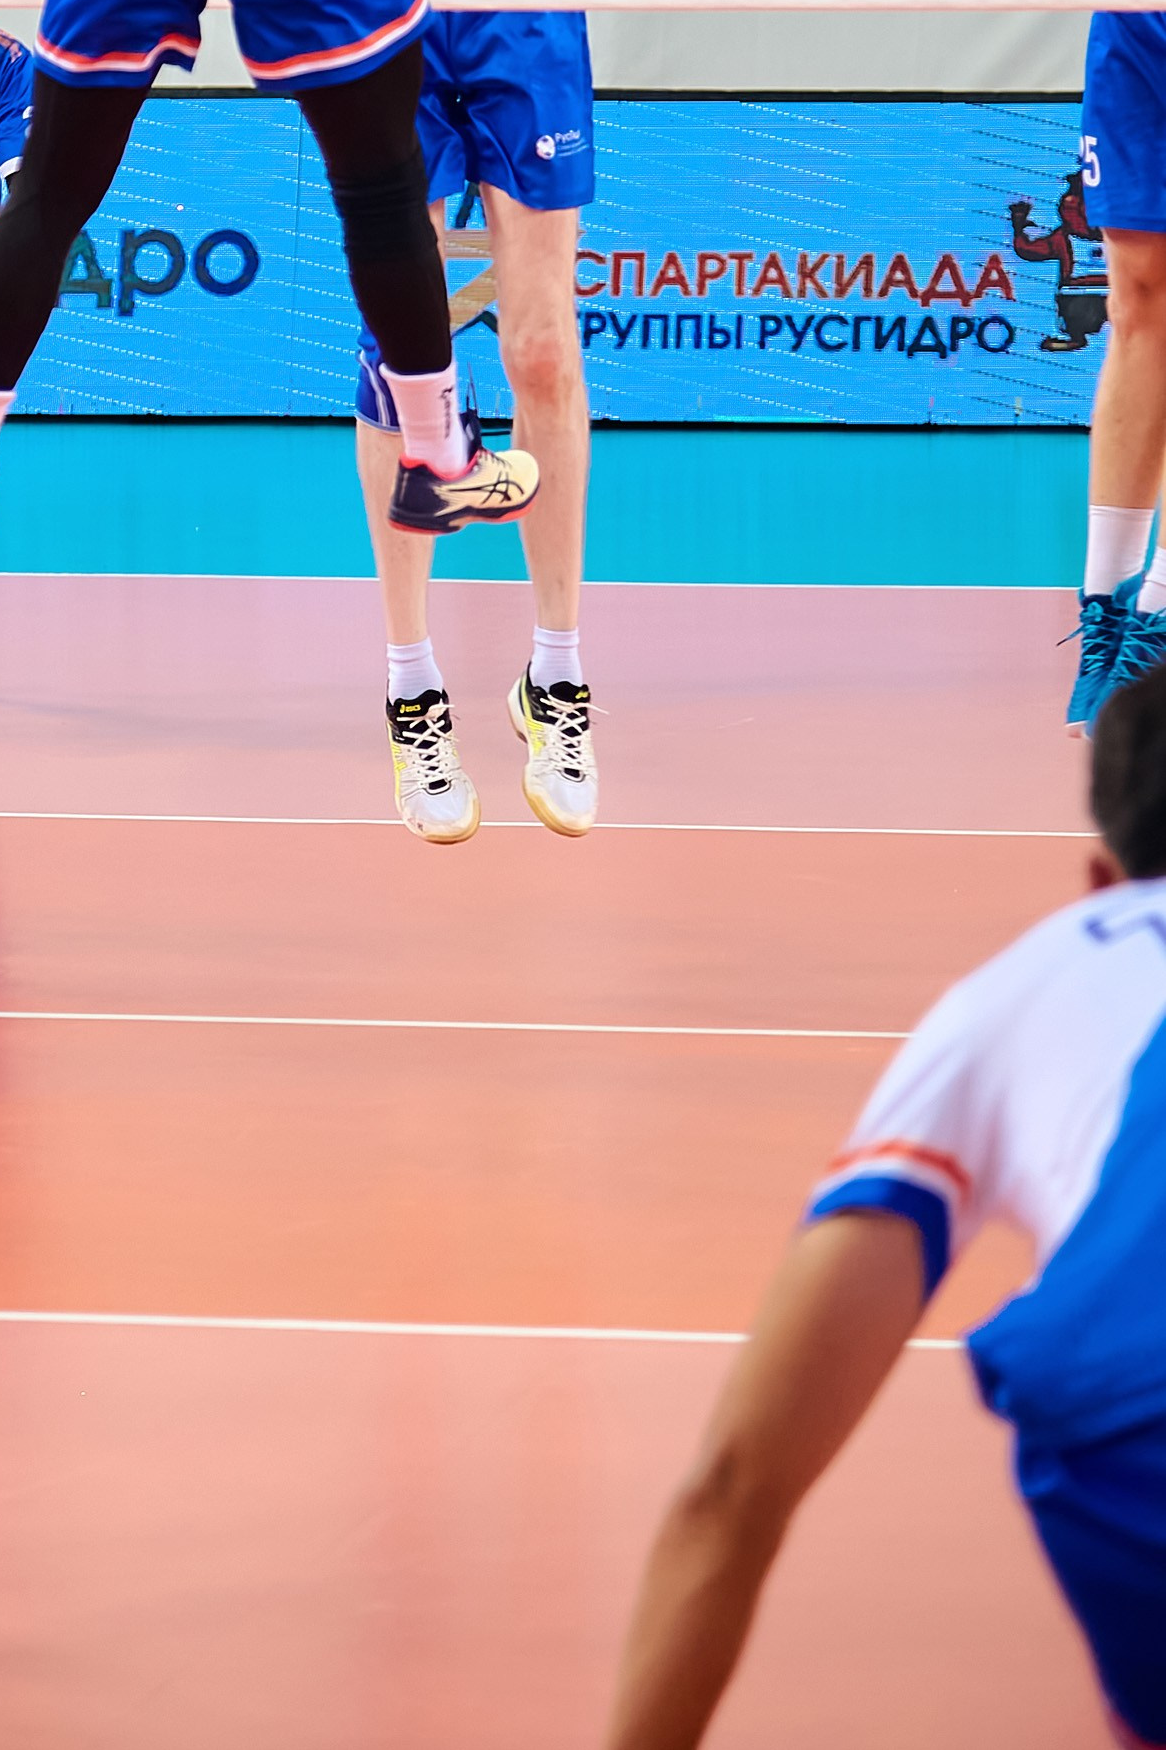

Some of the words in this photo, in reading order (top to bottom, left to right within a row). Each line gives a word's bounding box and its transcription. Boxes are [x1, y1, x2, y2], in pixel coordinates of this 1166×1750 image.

[1079, 135, 1101, 187] 5
[56, 230, 260, 316] дро
[575, 251, 1015, 308] СПАРТАКИАДА
[578, 311, 744, 350] РУППЫ
[759, 314, 1017, 359] РУСГИДРО
